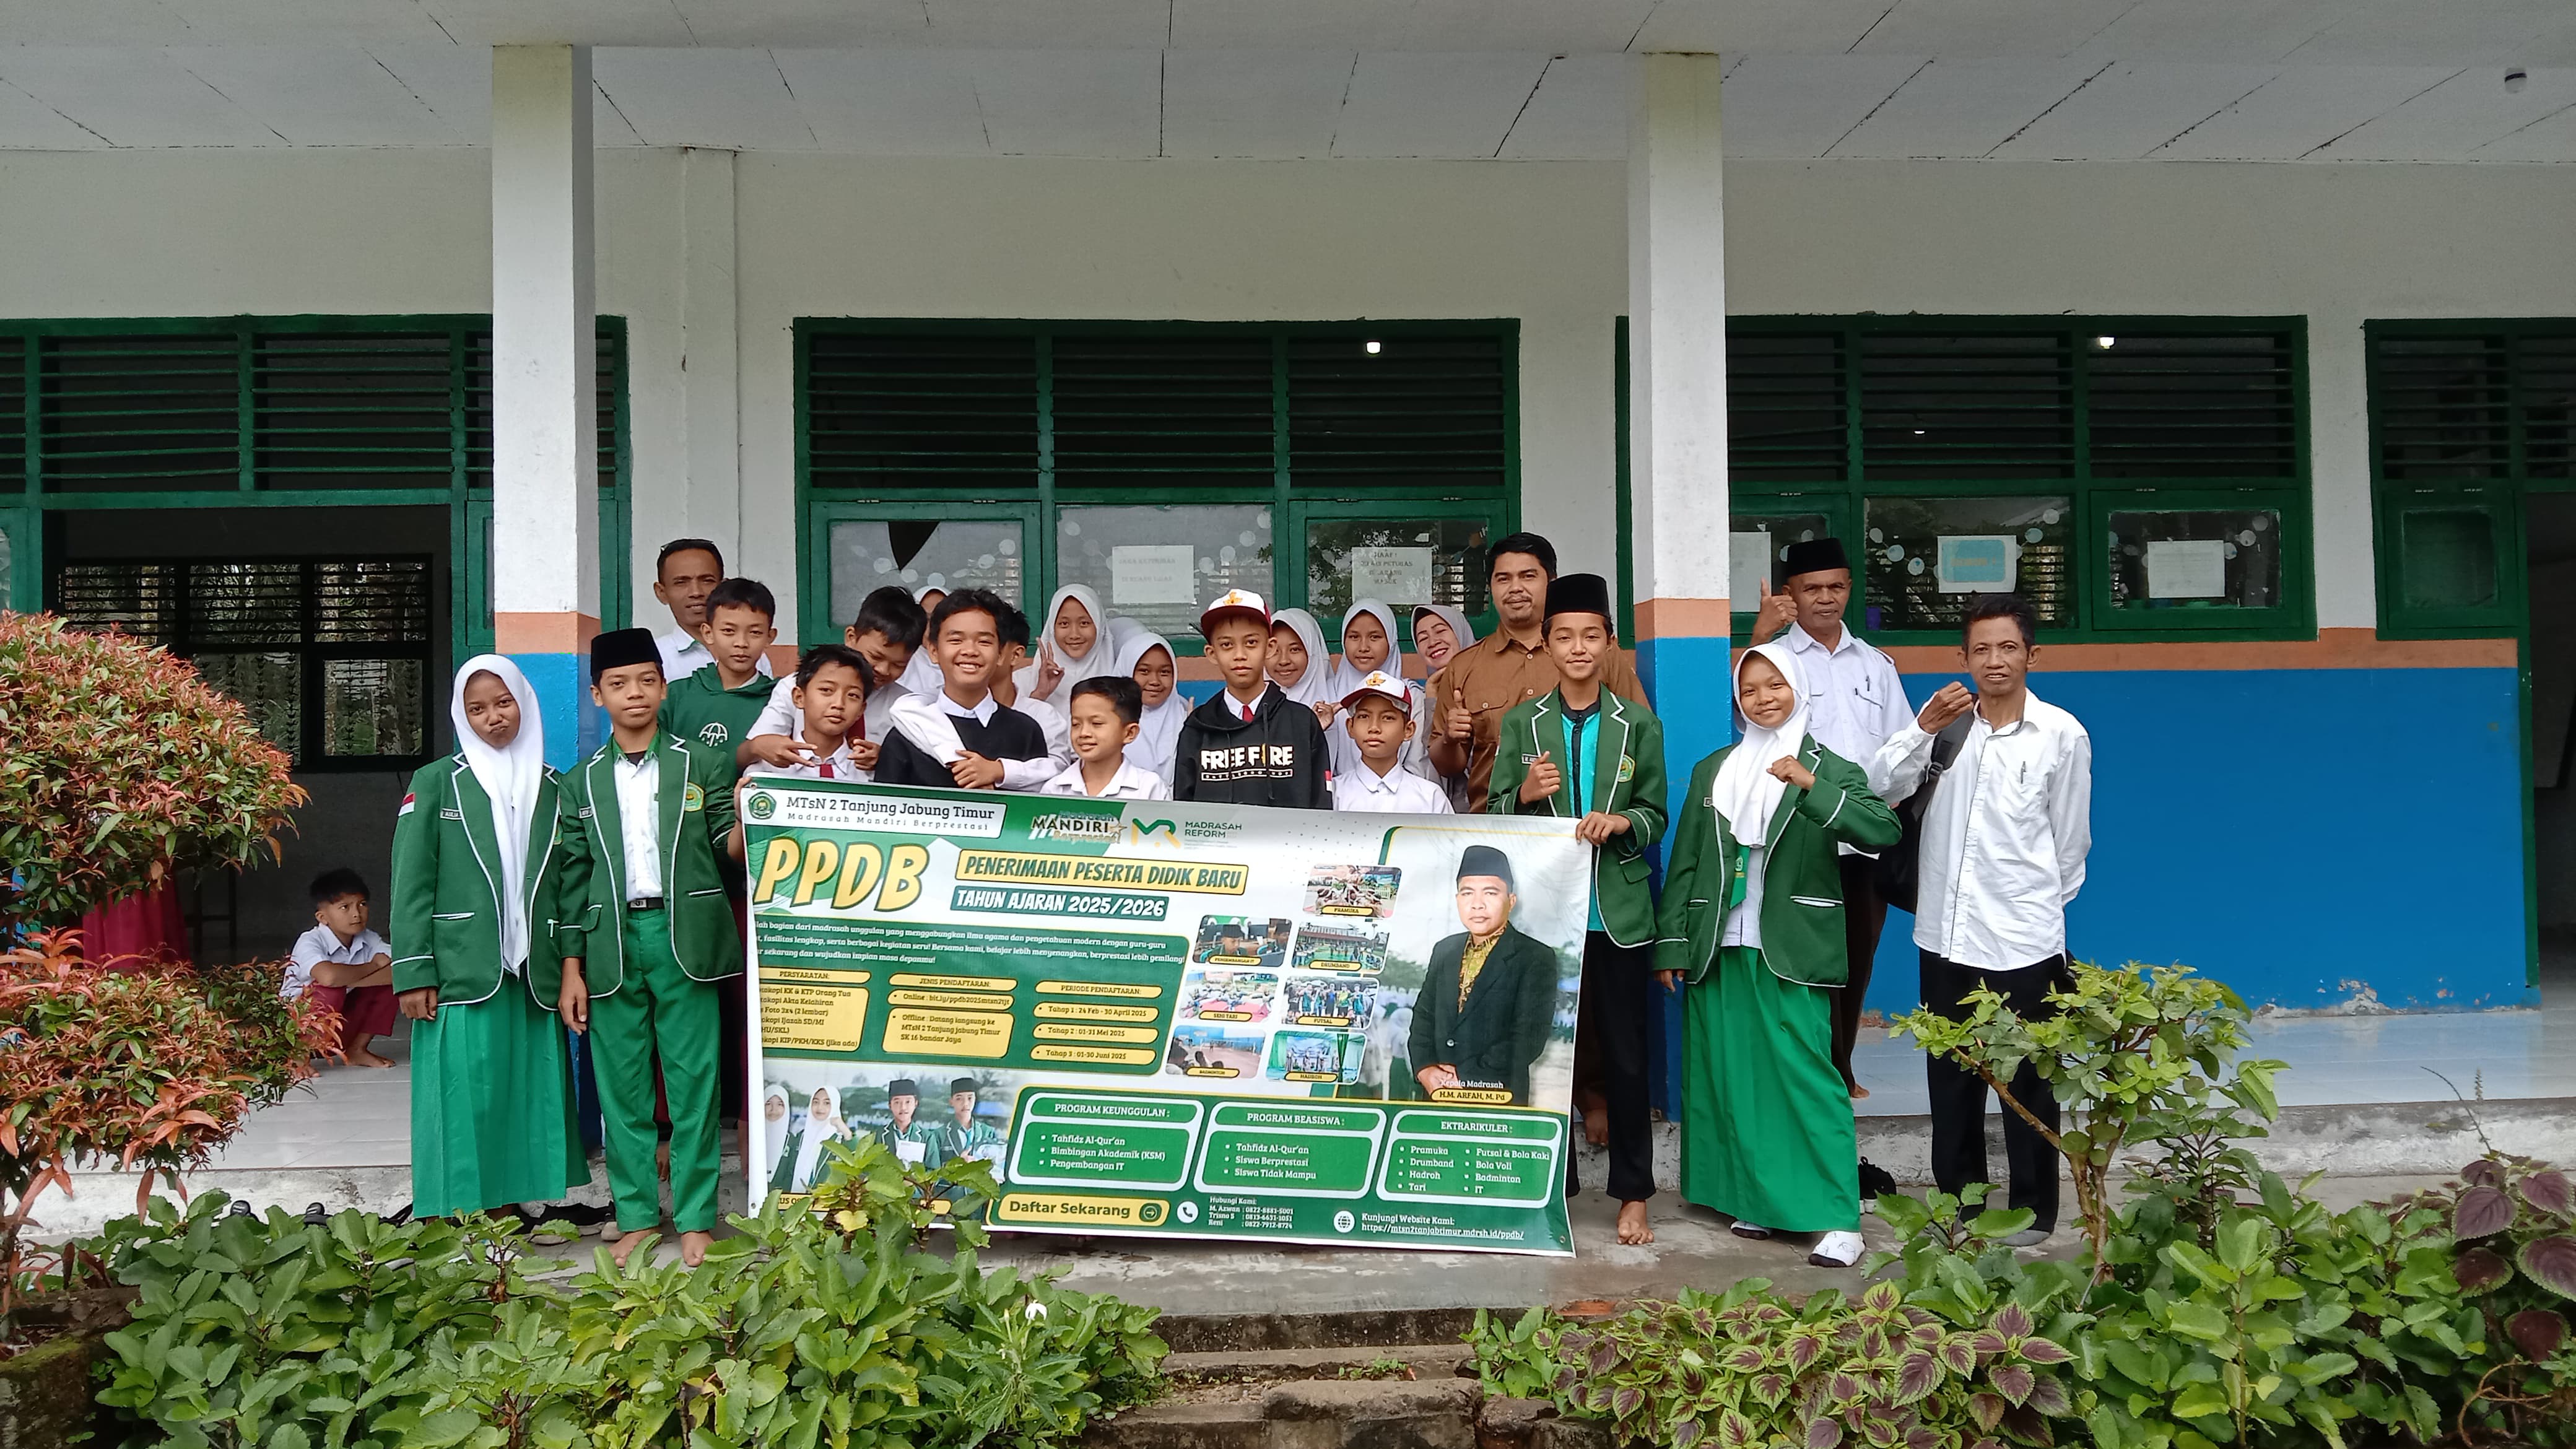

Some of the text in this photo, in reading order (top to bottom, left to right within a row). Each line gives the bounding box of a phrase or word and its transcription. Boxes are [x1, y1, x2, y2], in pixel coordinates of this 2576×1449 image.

[1200, 743, 1294, 770] FREE FIRE
[787, 797, 994, 819] MTsN 2 Tanjung Jabung Timur
[788, 812, 988, 830] Madrasah Mandiri Berprestasi
[1032, 816, 1108, 833] MANDIRI
[1185, 822, 1242, 830] MADRASAH
[1185, 829, 1225, 838] REFORM
[753, 836, 929, 912] PPDB
[964, 856, 1242, 889] PENERIMAAN PESERTA DIDIK BARU
[957, 890, 1165, 916] TAHUN AJARAN 2025/2026
[770, 922, 794, 931] bagian
[812, 924, 849, 932] madrasah
[851, 926, 884, 936] unggulan
[886, 928, 903, 937] yang
[905, 928, 965, 939] menggabungkan
[985, 934, 1009, 942] agama
[1025, 935, 1072, 946] pengetahuan
[1074, 937, 1100, 945] modern
[1102, 939, 1128, 948] dengan
[1129, 941, 1166, 949] guru-guru
[764, 949, 798, 959] sekarang
[815, 952, 851, 960] wujudkan
[932, 943, 964, 952] Bersama
[986, 946, 1012, 955] belajar
[1090, 951, 1130, 961] berprestasi
[1131, 953, 1149, 961] lebih
[1048, 1006, 1069, 1014] Tahap
[927, 1025, 954, 1034] Tanjung
[1048, 1027, 1069, 1035] Tahap
[1046, 1050, 1067, 1058] Tahap
[1467, 1080, 1503, 1089] Madrasah
[1055, 1103, 1165, 1116] PROGRAM KEUNGGULAN
[1247, 1113, 1341, 1125] PROGRAM BEASISWA
[1441, 1121, 1508, 1133] EKTRARIKULER
[1051, 1134, 1084, 1144] Tahfidz
[1236, 1143, 1268, 1152] Tahfidz
[1410, 1146, 1448, 1155] Pramuka
[1051, 1147, 1165, 1161] Bimbingan Akademik (KSM)
[1476, 1148, 1502, 1157] Futsal
[1512, 1150, 1530, 1159] Bola
[1531, 1151, 1549, 1160] Kaki
[1050, 1159, 1125, 1171] Pengembangan IT
[1235, 1155, 1308, 1168] Siswa Berprestasi
[1410, 1159, 1454, 1168] Drumband
[1476, 1161, 1512, 1170] Bola Voli
[1235, 1168, 1316, 1181] Siswa Tidak Mampu
[1409, 1170, 1440, 1180] Hadroh
[1475, 1173, 1521, 1183] Badminton
[1408, 1183, 1426, 1191] Tari
[1475, 1185, 1484, 1194] IT
[1210, 1196, 1237, 1205] Hubungi
[1009, 1201, 1130, 1219] Daftar Sekarang
[1362, 1213, 1455, 1225] Kunjungi Website Kami:
